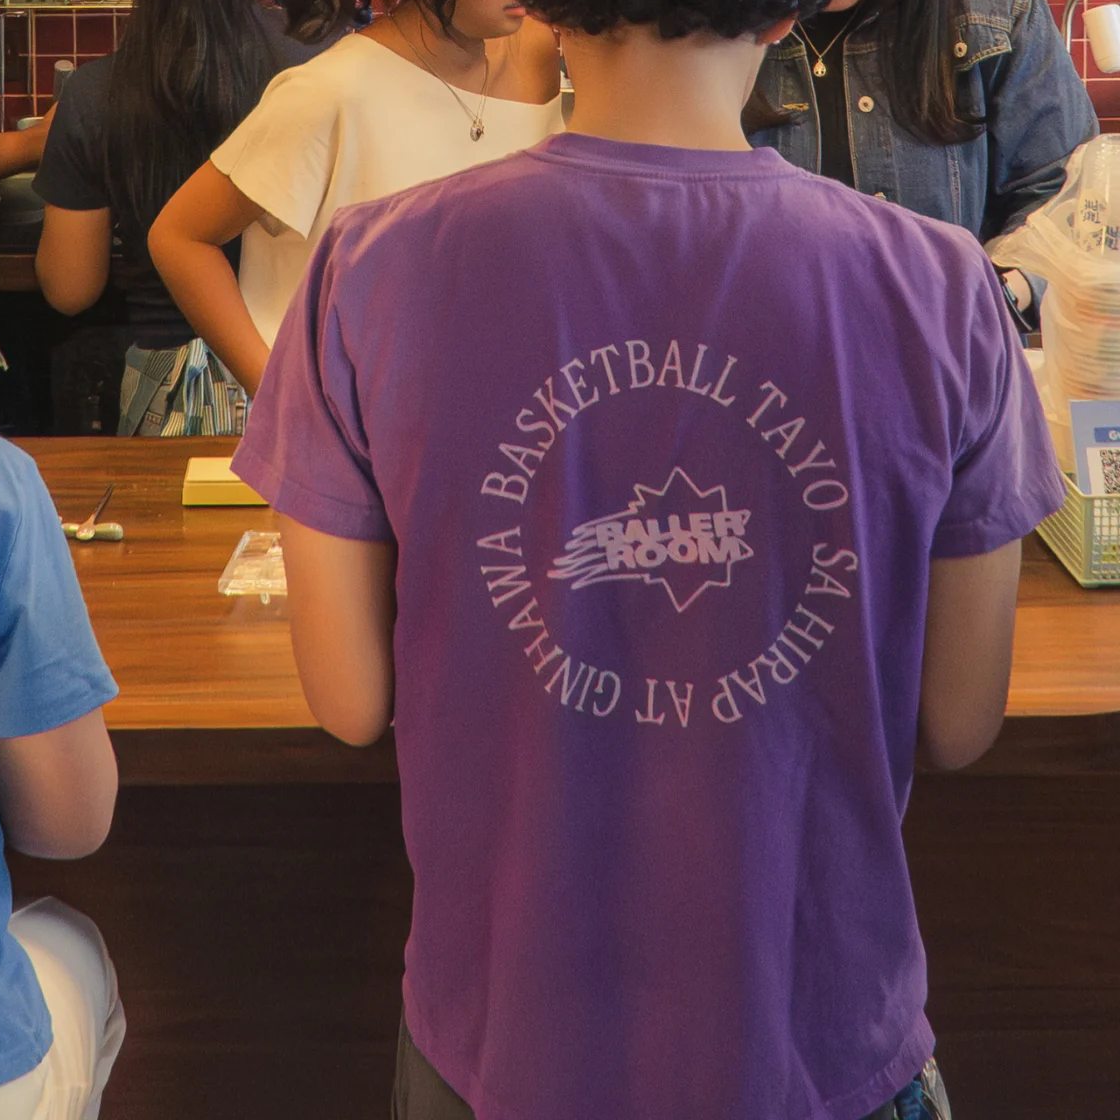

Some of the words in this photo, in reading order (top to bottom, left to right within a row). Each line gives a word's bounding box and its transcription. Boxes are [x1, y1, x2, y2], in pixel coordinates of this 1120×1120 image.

[481, 339, 737, 504] BASKETBALL
[746, 380, 849, 511] TAYO
[595, 509, 750, 548] BALLER
[605, 536, 744, 570] ROOM
[805, 542, 858, 599] SA
[477, 526, 621, 717] GINHAWA
[712, 603, 835, 724] HIRAP
[635, 679, 694, 728] AT
